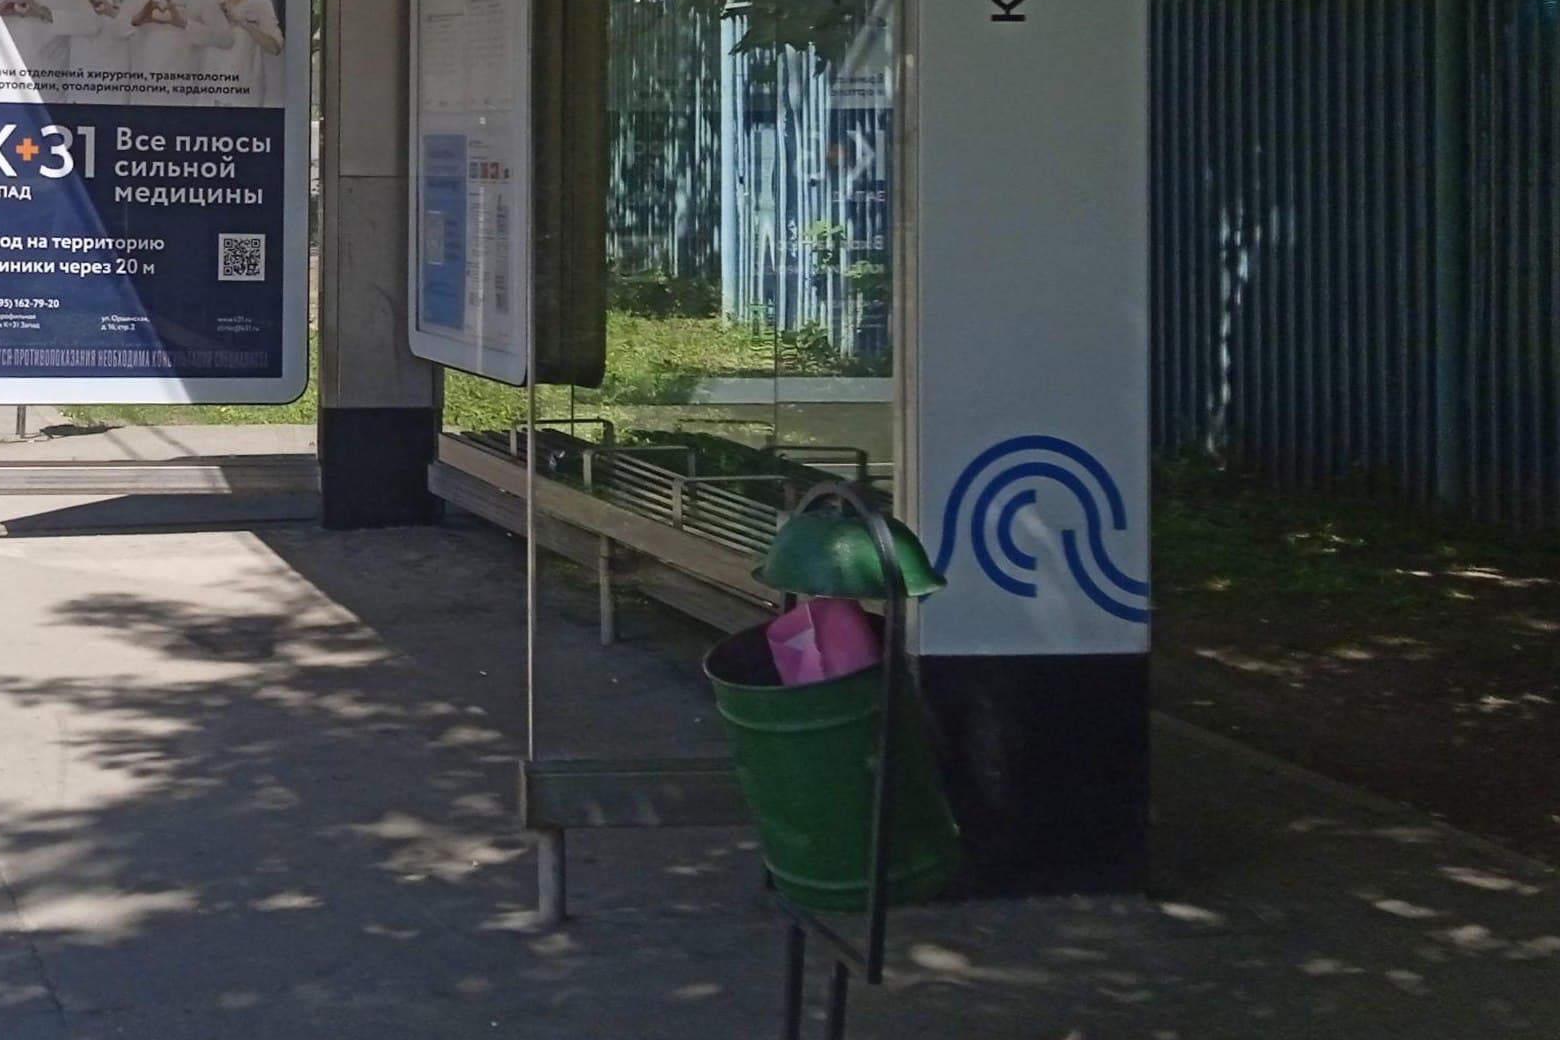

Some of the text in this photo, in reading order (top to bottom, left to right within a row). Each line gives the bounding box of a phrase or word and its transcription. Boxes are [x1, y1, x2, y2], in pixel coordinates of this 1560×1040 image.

[19, 68, 84, 79] отделений
[87, 70, 148, 81] хирургии,
[149, 72, 240, 82] травматологии
[61, 84, 170, 94] отоларингологии,
[172, 87, 251, 95] кардиологии
[116, 127, 271, 153] Все плюсы
[114, 156, 236, 178] сильной
[115, 186, 263, 206] медицины
[27, 237, 48, 249] на
[51, 236, 166, 253] территорию
[59, 262, 112, 277] через
[115, 258, 138, 275] 20
[142, 265, 156, 274] м
[14, 299, 60, 308] 162-79-20
